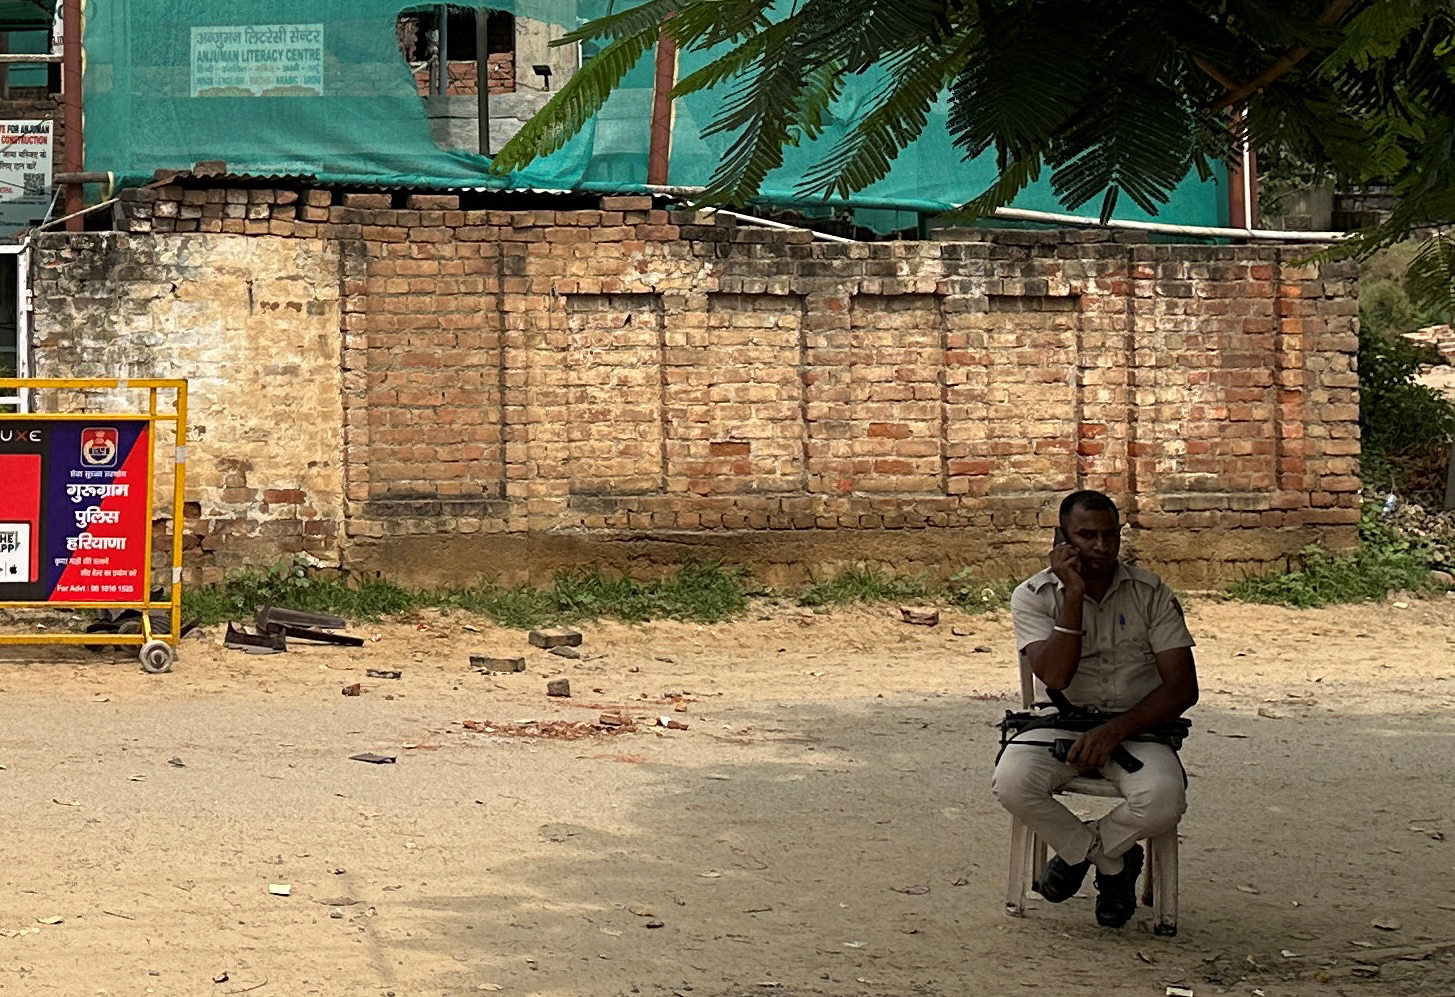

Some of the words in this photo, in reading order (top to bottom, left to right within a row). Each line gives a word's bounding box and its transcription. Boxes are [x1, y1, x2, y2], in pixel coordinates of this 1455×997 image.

[244, 26, 287, 44] लिटरेसी
[197, 50, 239, 63] ANJUMAN
[242, 49, 283, 62] LITERACY
[286, 48, 321, 62] CENTRE
[7, 124, 19, 133] FOR
[1, 135, 48, 145] CONSTRUCTION
[74, 505, 121, 529] पुलिस
[66, 531, 127, 551] हरियाणा
[56, 584, 69, 592] For
